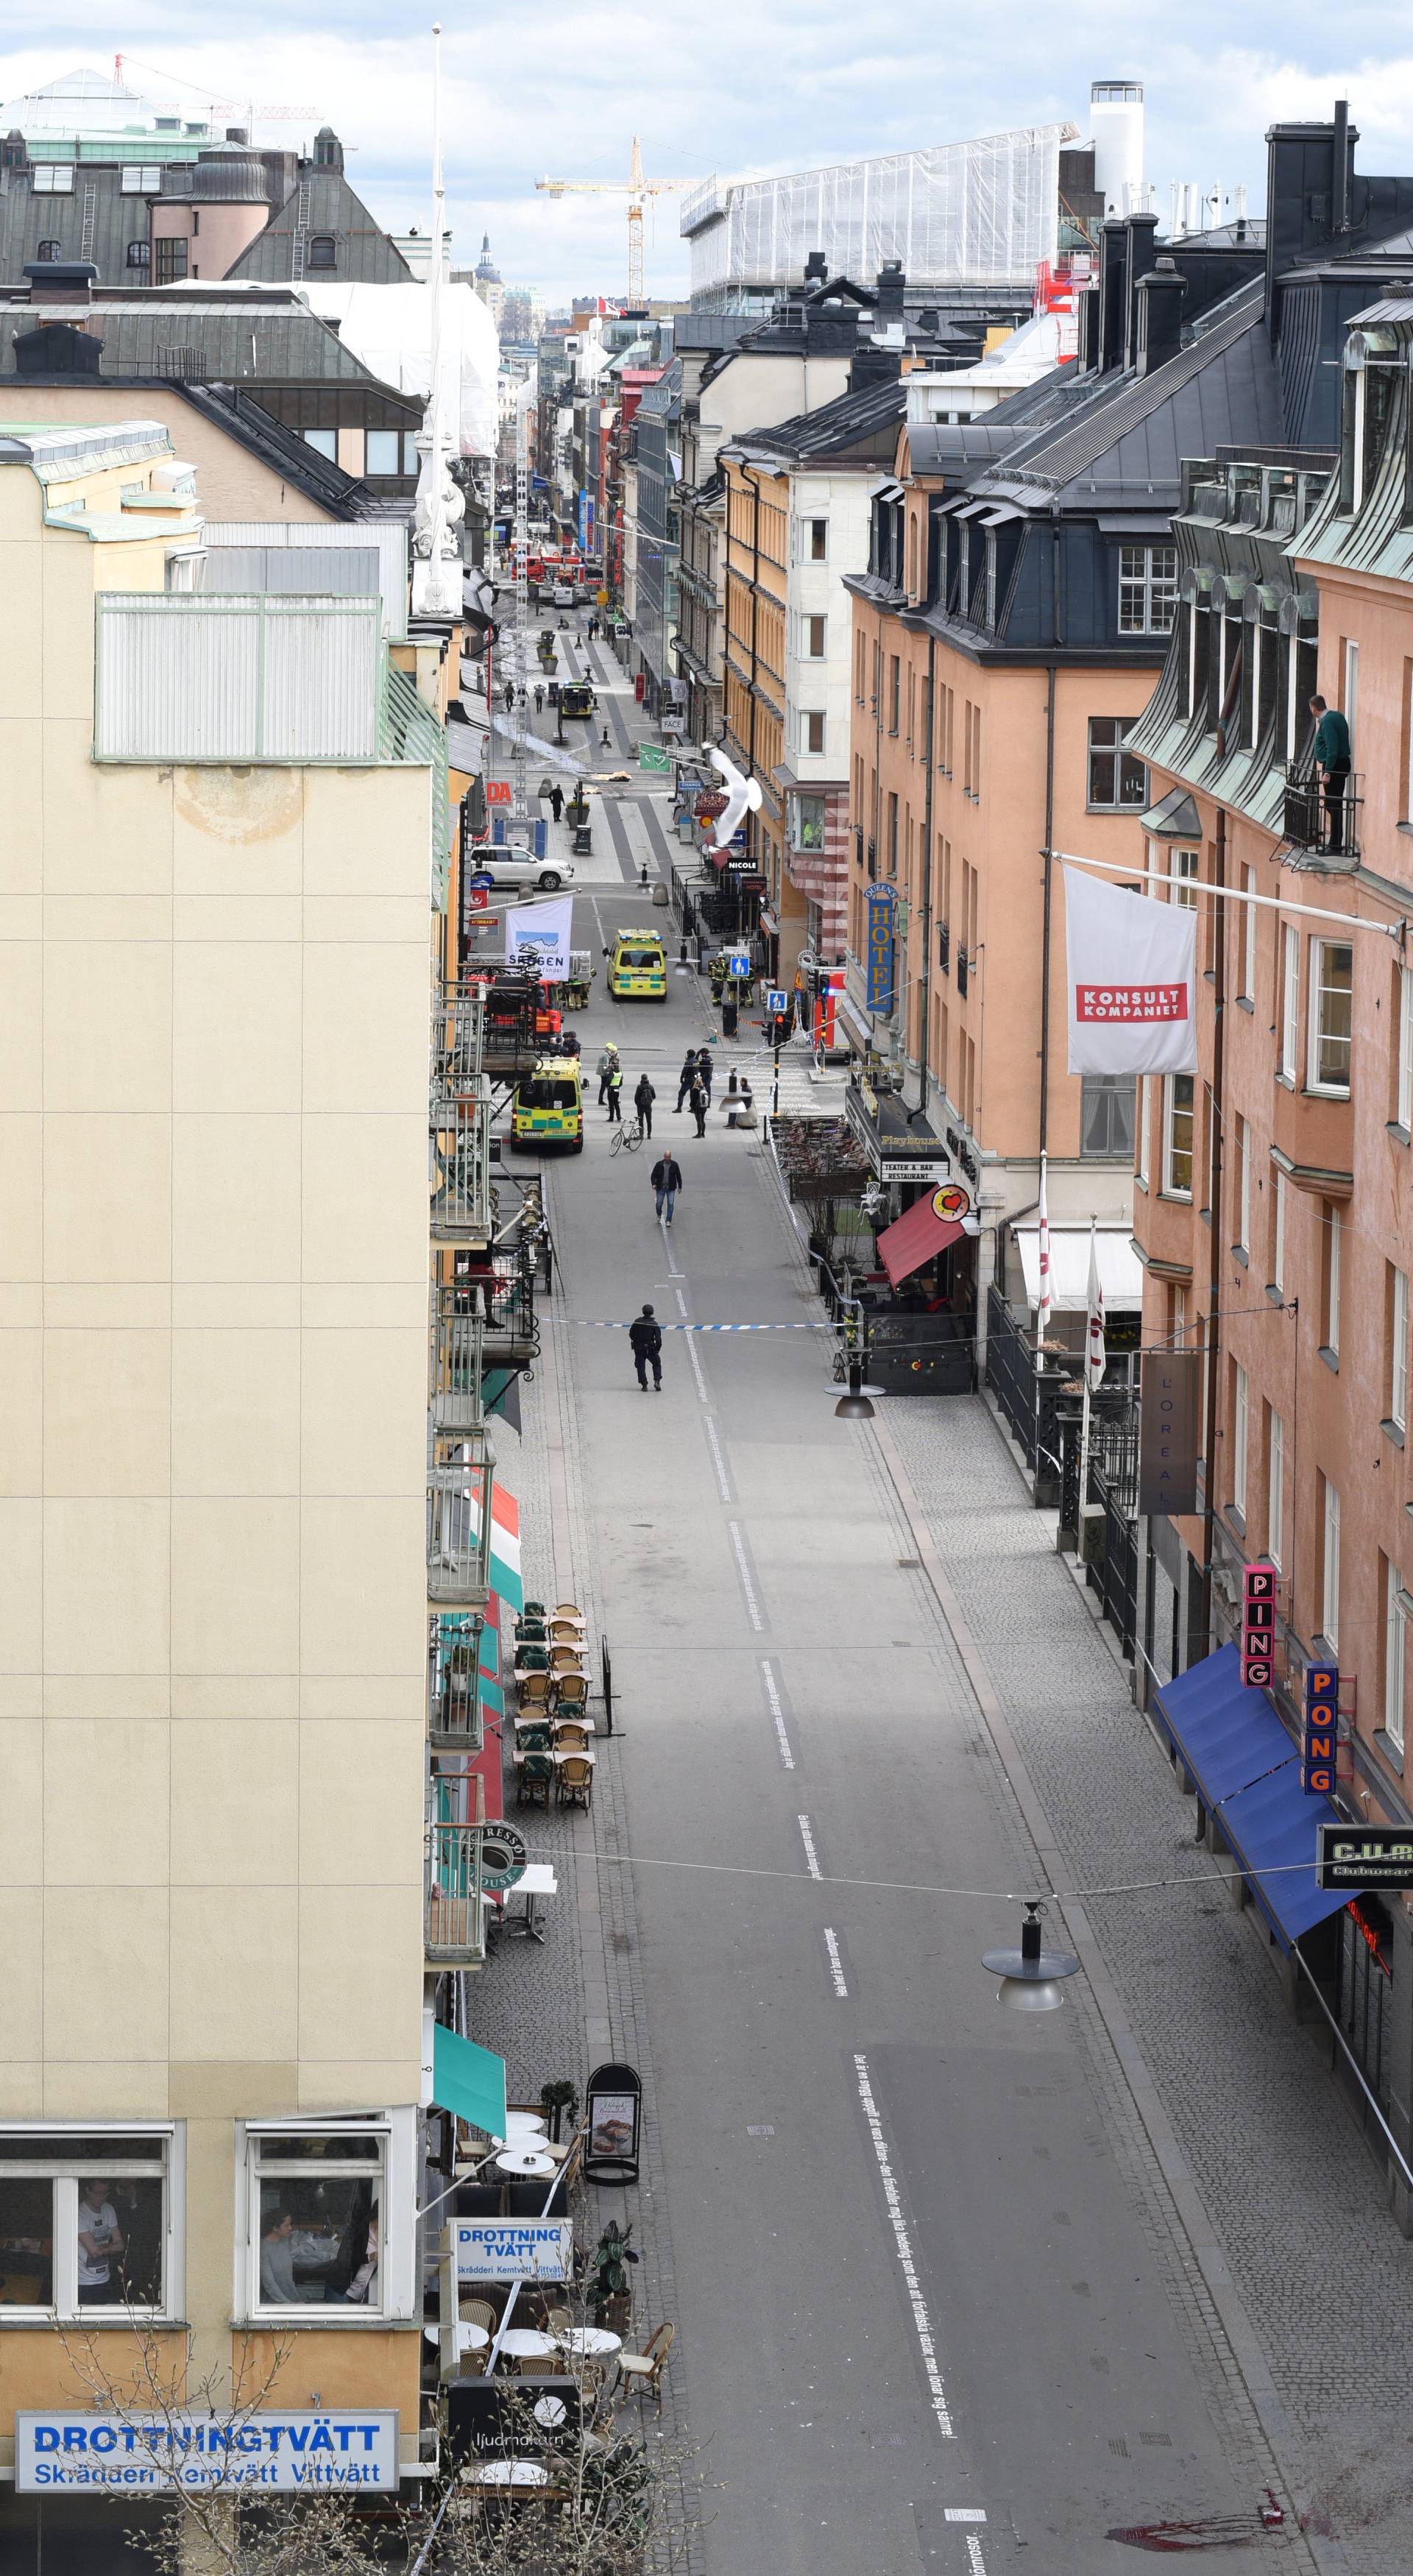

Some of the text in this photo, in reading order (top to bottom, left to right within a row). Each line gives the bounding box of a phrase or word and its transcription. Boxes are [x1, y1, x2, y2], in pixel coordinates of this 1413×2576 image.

[486, 782, 511, 802] DA
[865, 885, 898, 899] QUEEN'S
[871, 907, 890, 1005] HOTEL
[1083, 990, 1179, 1005] KONSULT
[1084, 1005, 1179, 1017] KOMPANIET
[882, 1136, 941, 1147] Playhouse
[1248, 1575, 1268, 1684] PING
[1310, 1673, 1332, 1791] PONG
[1333, 1866, 1413, 1876] Clubwear
[830, 1958, 841, 1967] bara
[833, 1975, 845, 1984] livet
[835, 1986, 848, 1996] Hela
[854, 2054, 866, 2063] Det
[859, 2080, 871, 2095] snygg
[863, 2097, 879, 2117] uppgift
[871, 2127, 882, 2139] vara
[880, 2165, 893, 2176] den
[883, 2178, 900, 2205] förefaller
[888, 2207, 904, 2218] mig
[892, 2220, 907, 2230] lika
[459, 2229, 561, 2242] DROTTNING
[484, 2243, 536, 2257] TVÄTT
[896, 2232, 913, 2257] hederlig
[902, 2260, 915, 2273] som
[907, 2276, 920, 2287] den
[910, 2290, 924, 2299] att
[920, 2334, 935, 2355] växlar,
[924, 2357, 938, 2373] men
[929, 2375, 944, 2394] lönar
[932, 2397, 949, 2408] sig
[937, 2411, 957, 2438] sämre!
[35, 2418, 380, 2453] DROTTNINGTVÄTT
[291, 2463, 380, 2483] Vittvätt
